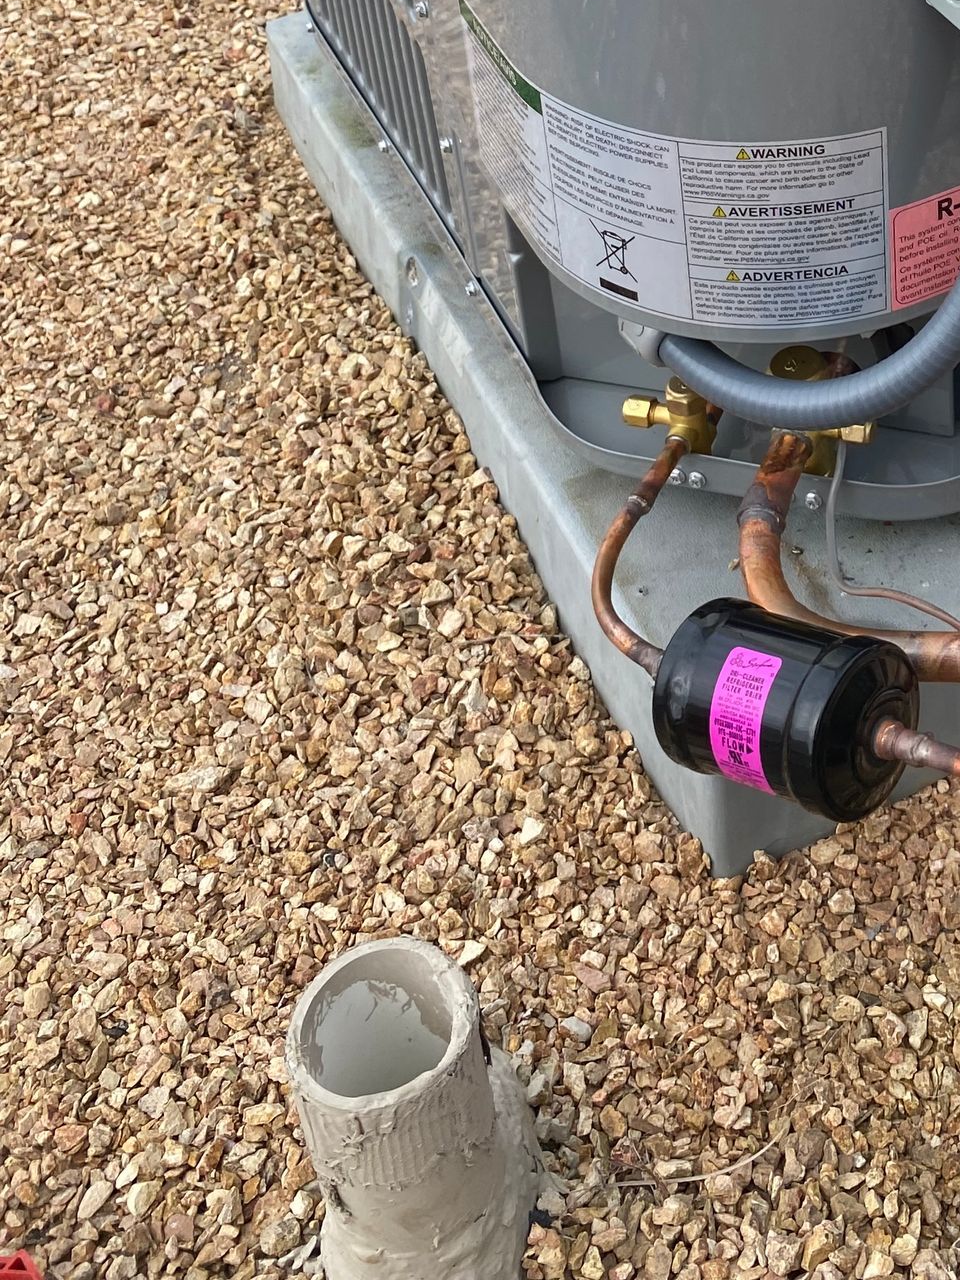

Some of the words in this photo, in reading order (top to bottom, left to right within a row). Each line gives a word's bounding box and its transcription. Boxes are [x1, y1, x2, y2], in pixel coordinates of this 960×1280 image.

[585, 123, 593, 131] OF
[594, 126, 625, 143] ELECTRIC
[653, 144, 670, 153] CAN
[585, 131, 595, 139] OR
[618, 144, 664, 160] DISCONNECT
[609, 148, 634, 161] POWER
[697, 162, 722, 170] product
[822, 155, 852, 165] including
[853, 151, 870, 160] Lead
[751, 144, 825, 159] WARNING
[728, 198, 856, 218] AVERTISSEMENT
[899, 234, 916, 244] This
[917, 223, 945, 238] system
[899, 242, 914, 254] and
[917, 234, 935, 247] POE
[899, 249, 925, 263] before
[925, 236, 959, 253] installing
[742, 265, 849, 282] ADVERTENCIA
[899, 266, 912, 274] Ce
[900, 275, 908, 283] et
[933, 258, 951, 271] POE
[900, 267, 956, 293] documentation
[900, 289, 922, 302] avant
[923, 277, 953, 293] installer
[721, 736, 745, 753] FLOW
